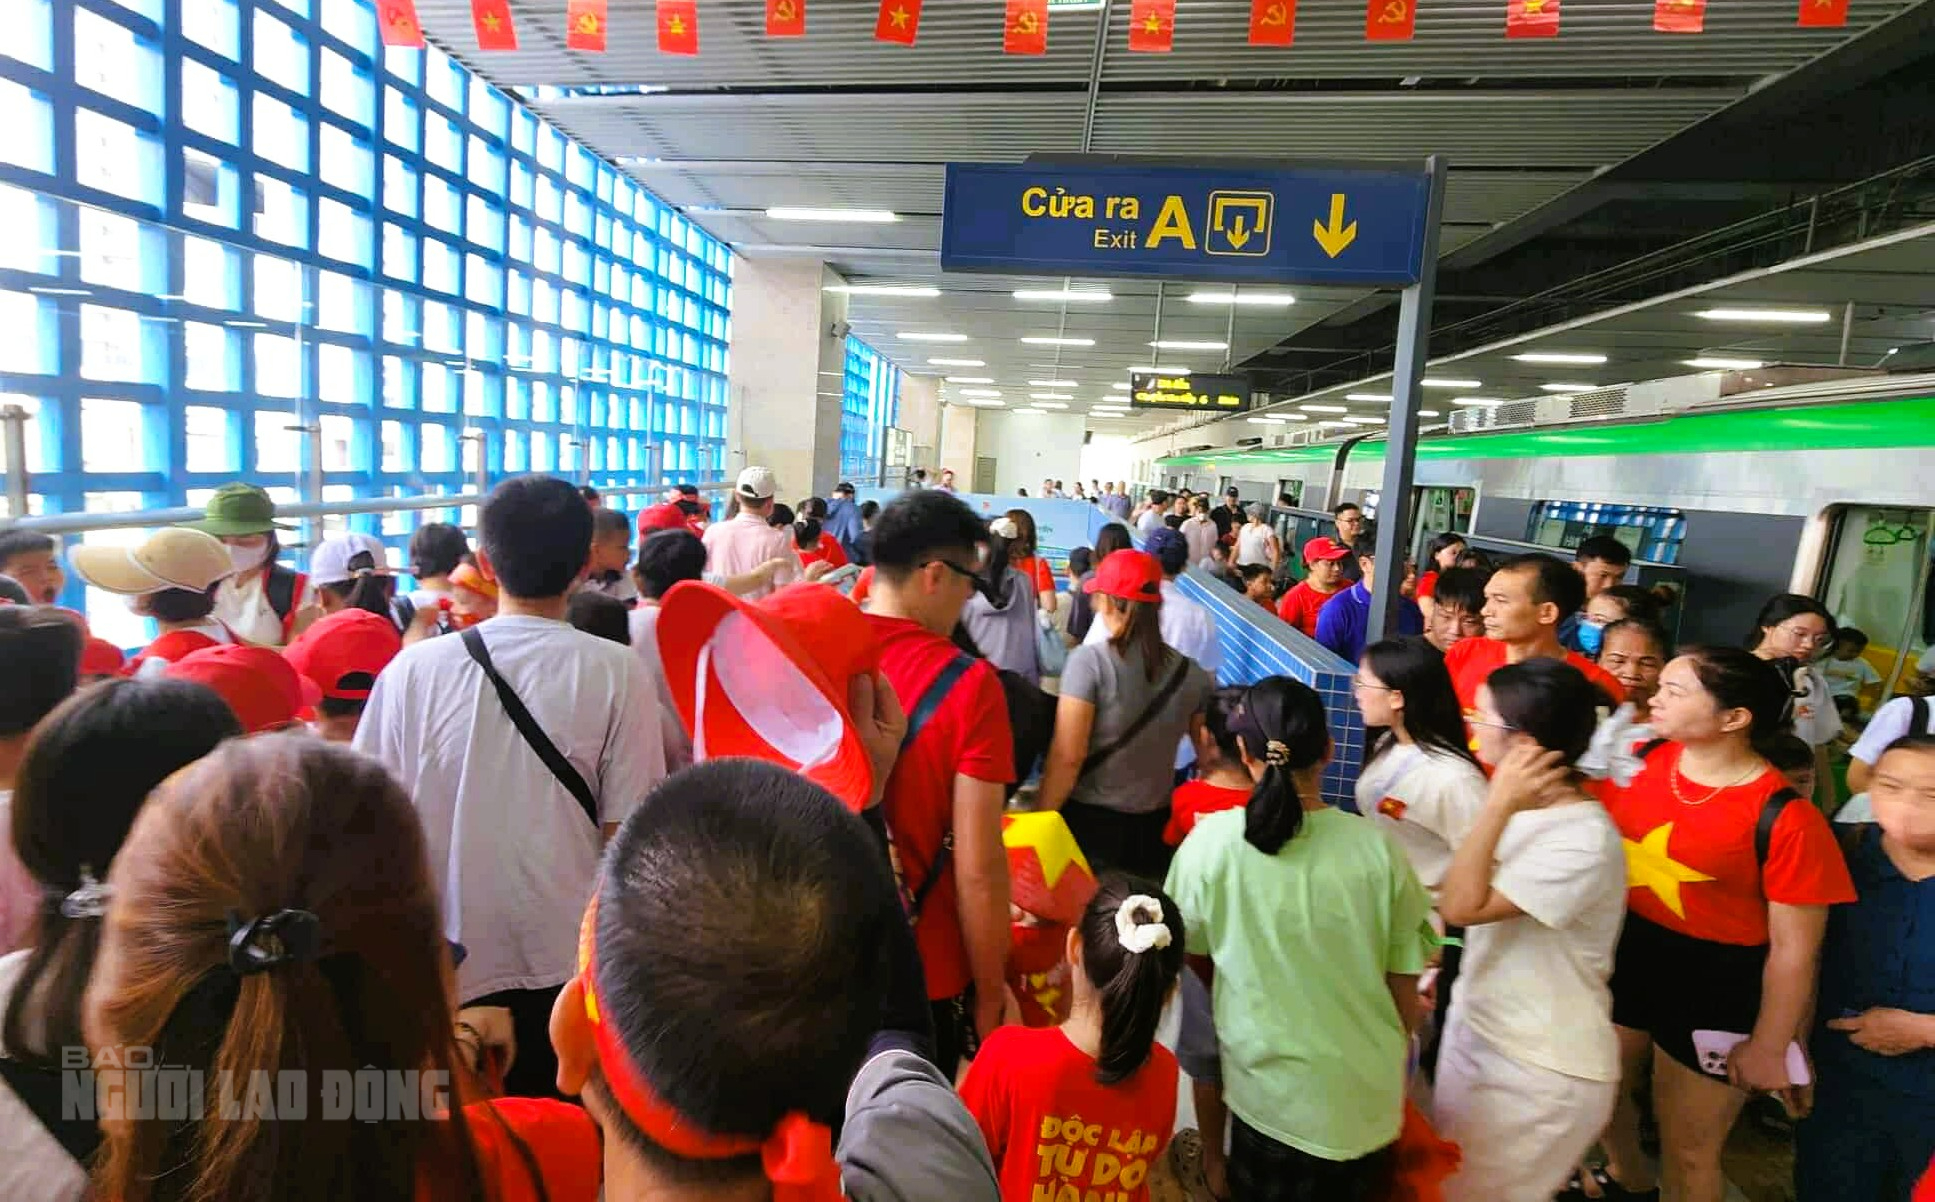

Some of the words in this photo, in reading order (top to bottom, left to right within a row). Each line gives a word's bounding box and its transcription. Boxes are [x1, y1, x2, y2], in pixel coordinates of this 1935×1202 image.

[1022, 186, 1095, 219] Cửa
[1106, 196, 1140, 219] ra
[1144, 195, 1197, 250] A
[1094, 229, 1137, 250] Exit
[1041, 1114, 1103, 1146] ĐỘC
[1108, 1128, 1158, 1160] LẬP
[1037, 1143, 1089, 1182] TỰ
[1091, 1153, 1148, 1191] DO
